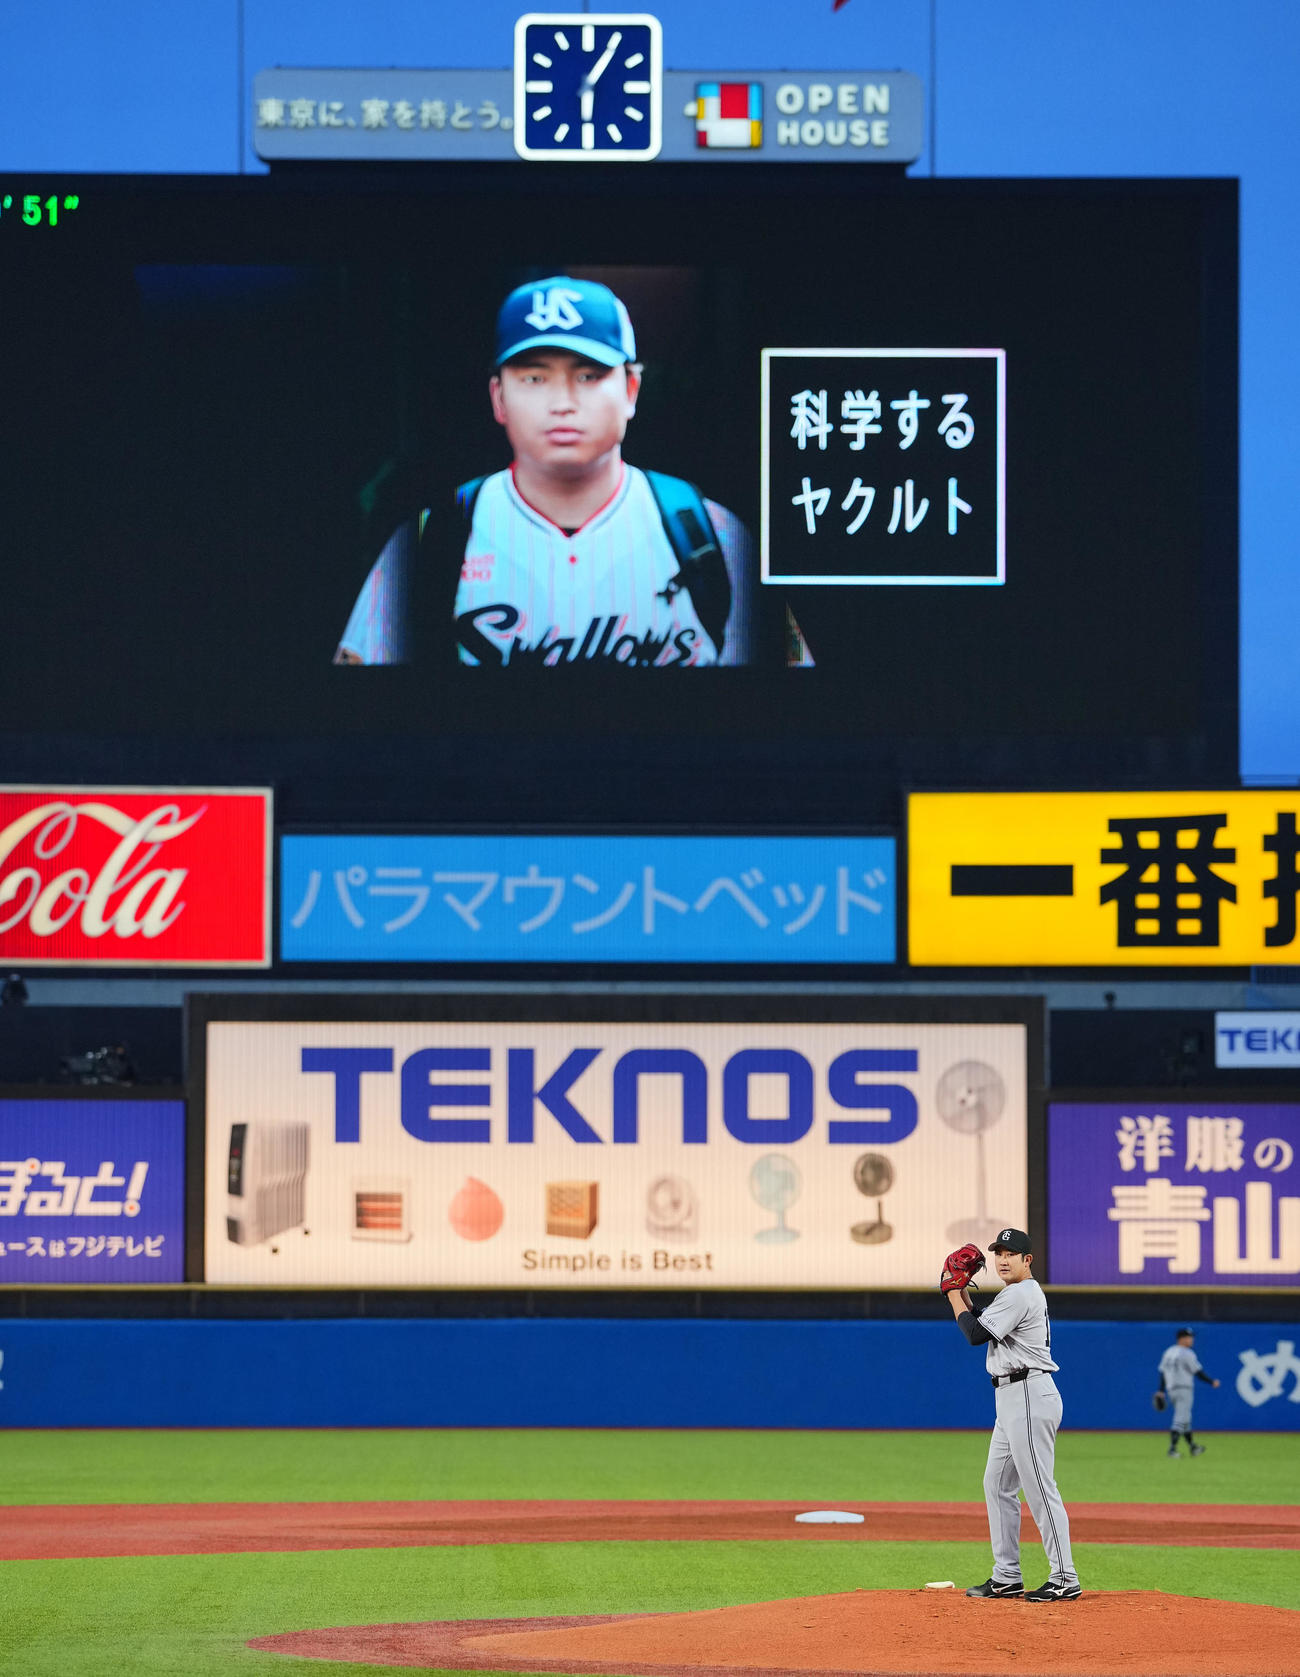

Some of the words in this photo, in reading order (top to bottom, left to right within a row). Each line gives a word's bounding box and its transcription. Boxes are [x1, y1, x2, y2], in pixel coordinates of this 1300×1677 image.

[257, 98, 514, 130] 東京に、家を持とう。
[776, 84, 891, 115] OPEN
[777, 119, 890, 147] HOUSE
[790, 389, 975, 450] 科学する
[791, 477, 972, 534] ヤクルト
[291, 865, 887, 934] パラマウントベッド
[1219, 1028, 1300, 1052] TEK
[301, 1047, 918, 1143] TEKNOS
[1116, 1115, 1294, 1172] 洋服の
[1107, 1178, 1300, 1274] 青山
[523, 1249, 611, 1272] Simple
[621, 1251, 643, 1271] is
[653, 1250, 713, 1271] Best
